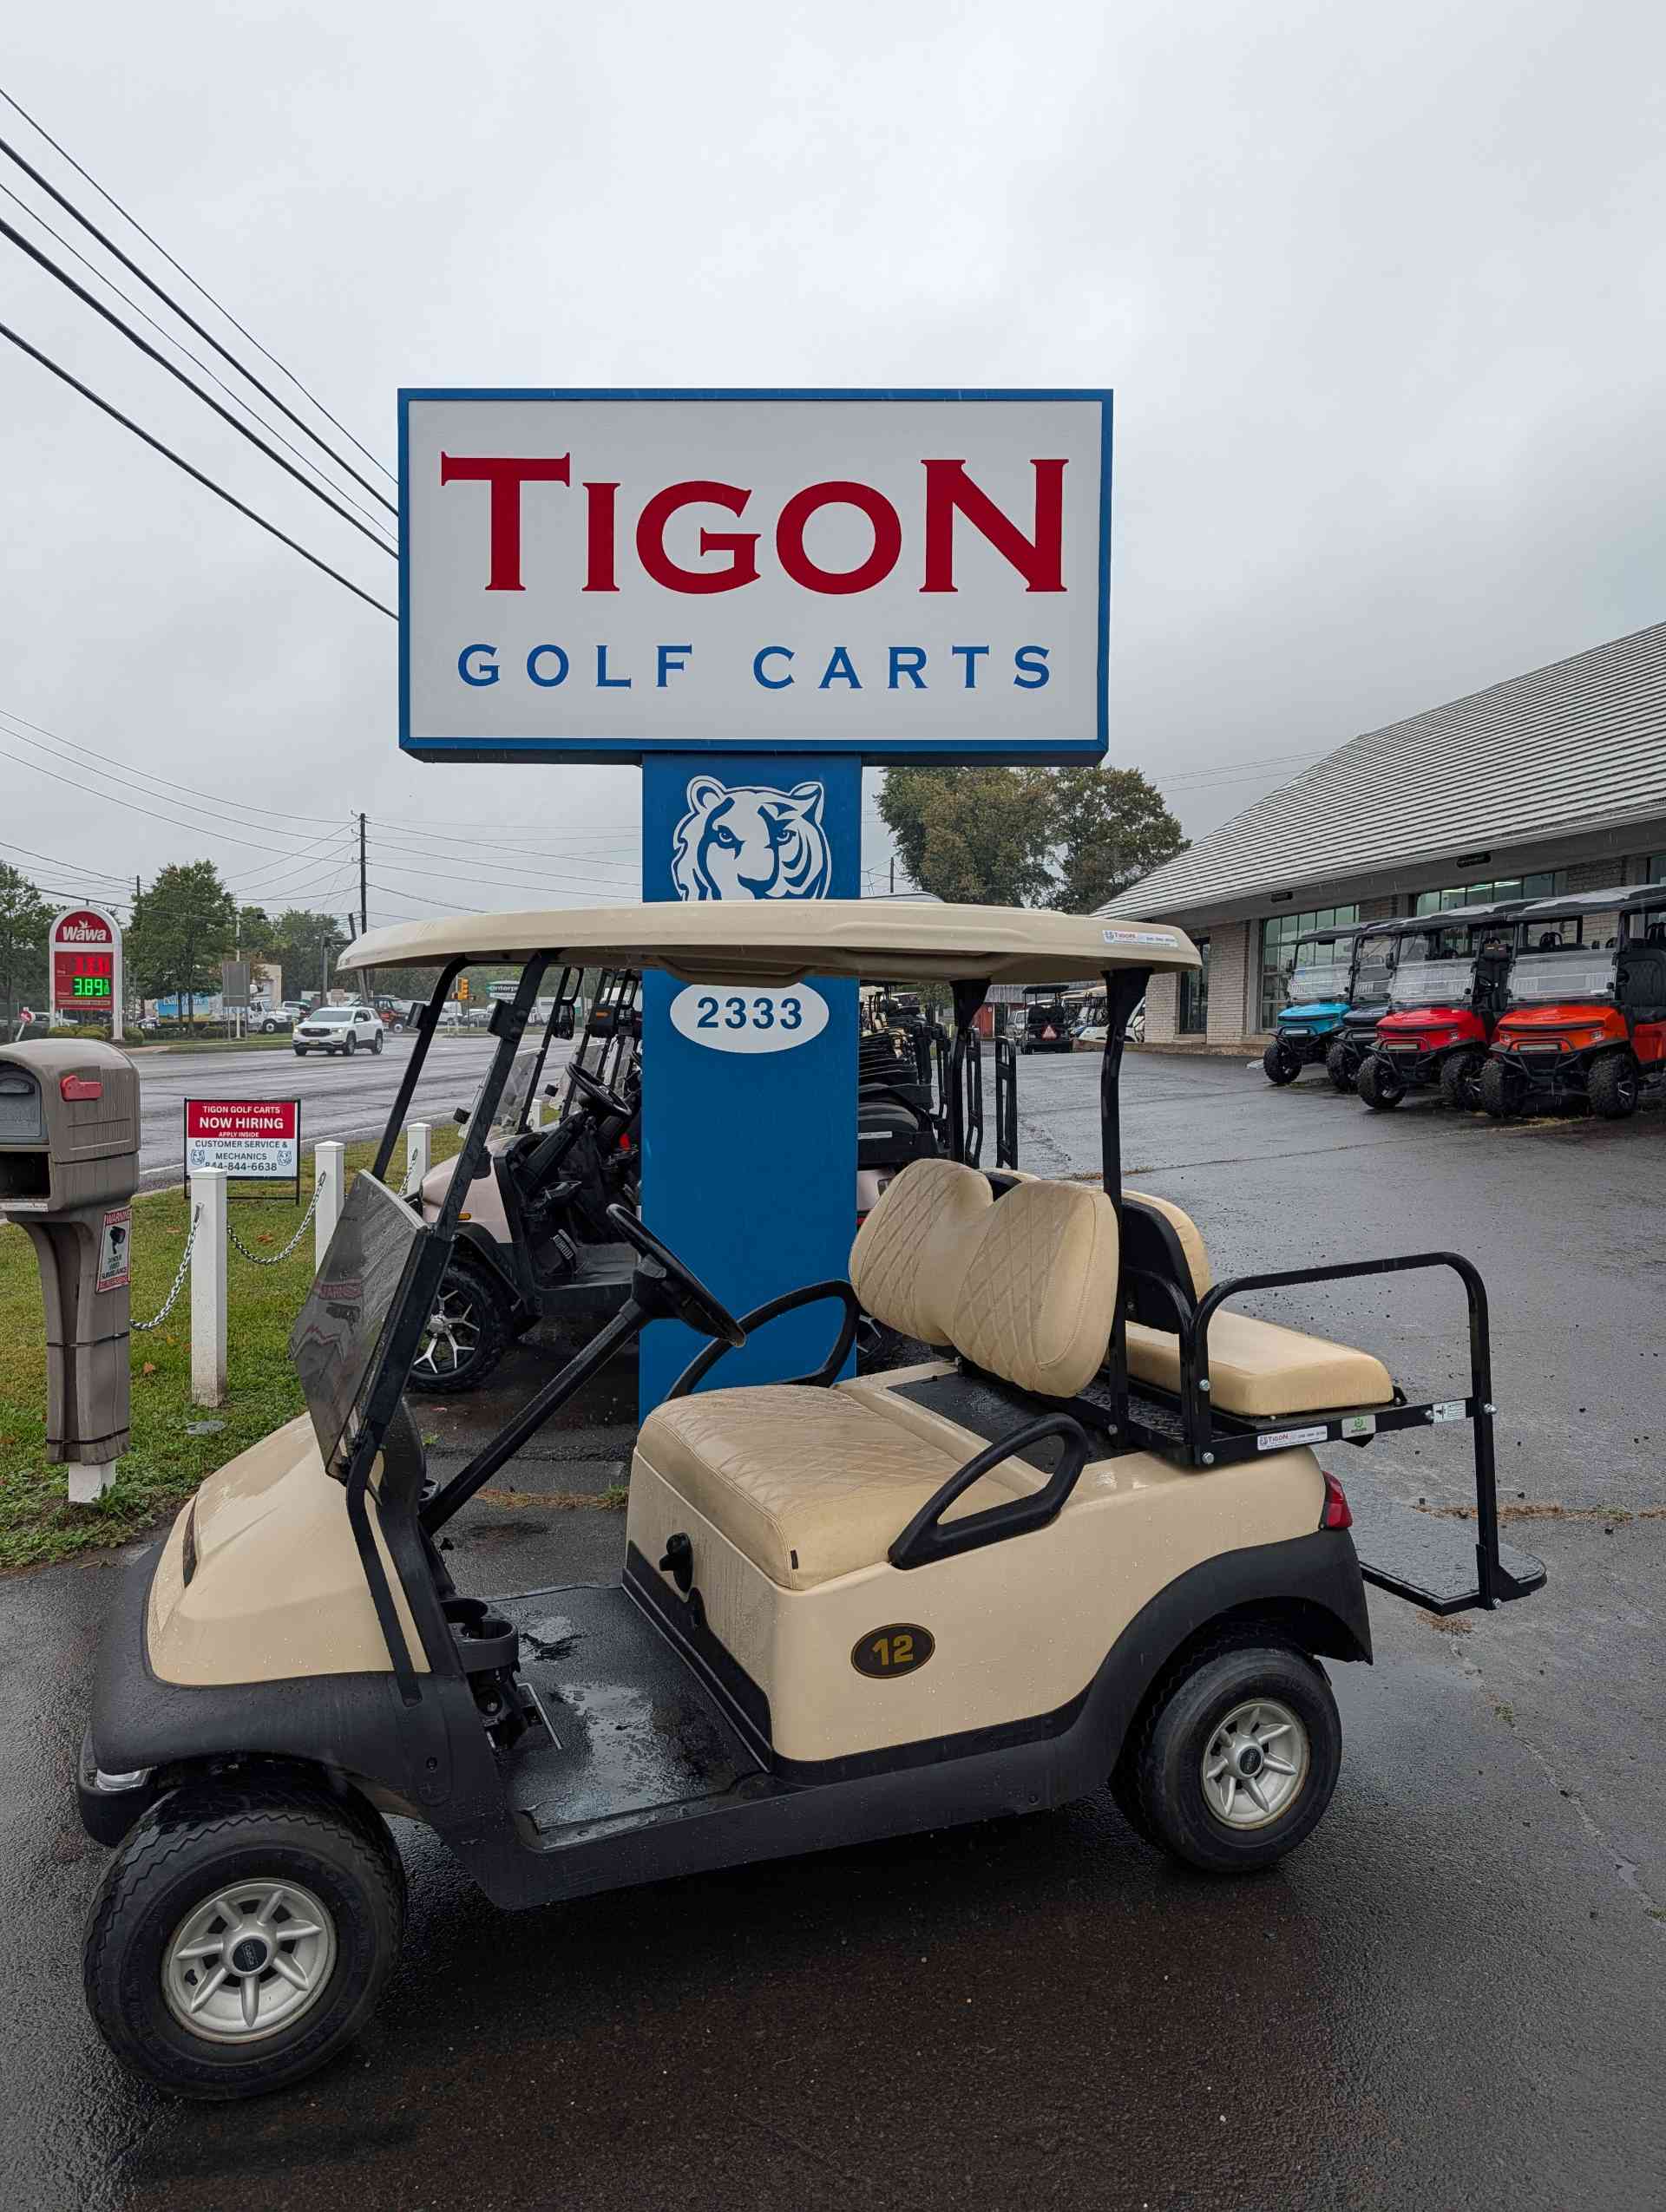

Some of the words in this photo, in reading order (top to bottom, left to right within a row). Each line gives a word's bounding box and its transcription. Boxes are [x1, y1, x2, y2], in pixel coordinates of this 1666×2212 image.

[441, 450, 1070, 594] TIGON
[457, 643, 692, 688] GOLF
[752, 645, 1050, 690] CARTS
[62, 926, 107, 942] Wawa
[697, 997, 803, 1030] 2333
[202, 1105, 229, 1114] TIGON
[199, 1116, 232, 1129] NOW
[235, 1117, 285, 1129] HIRING
[195, 1140, 243, 1149] CUSTOMER
[215, 1152, 267, 1161] MECHANICS
[871, 1634, 915, 1666] 12
